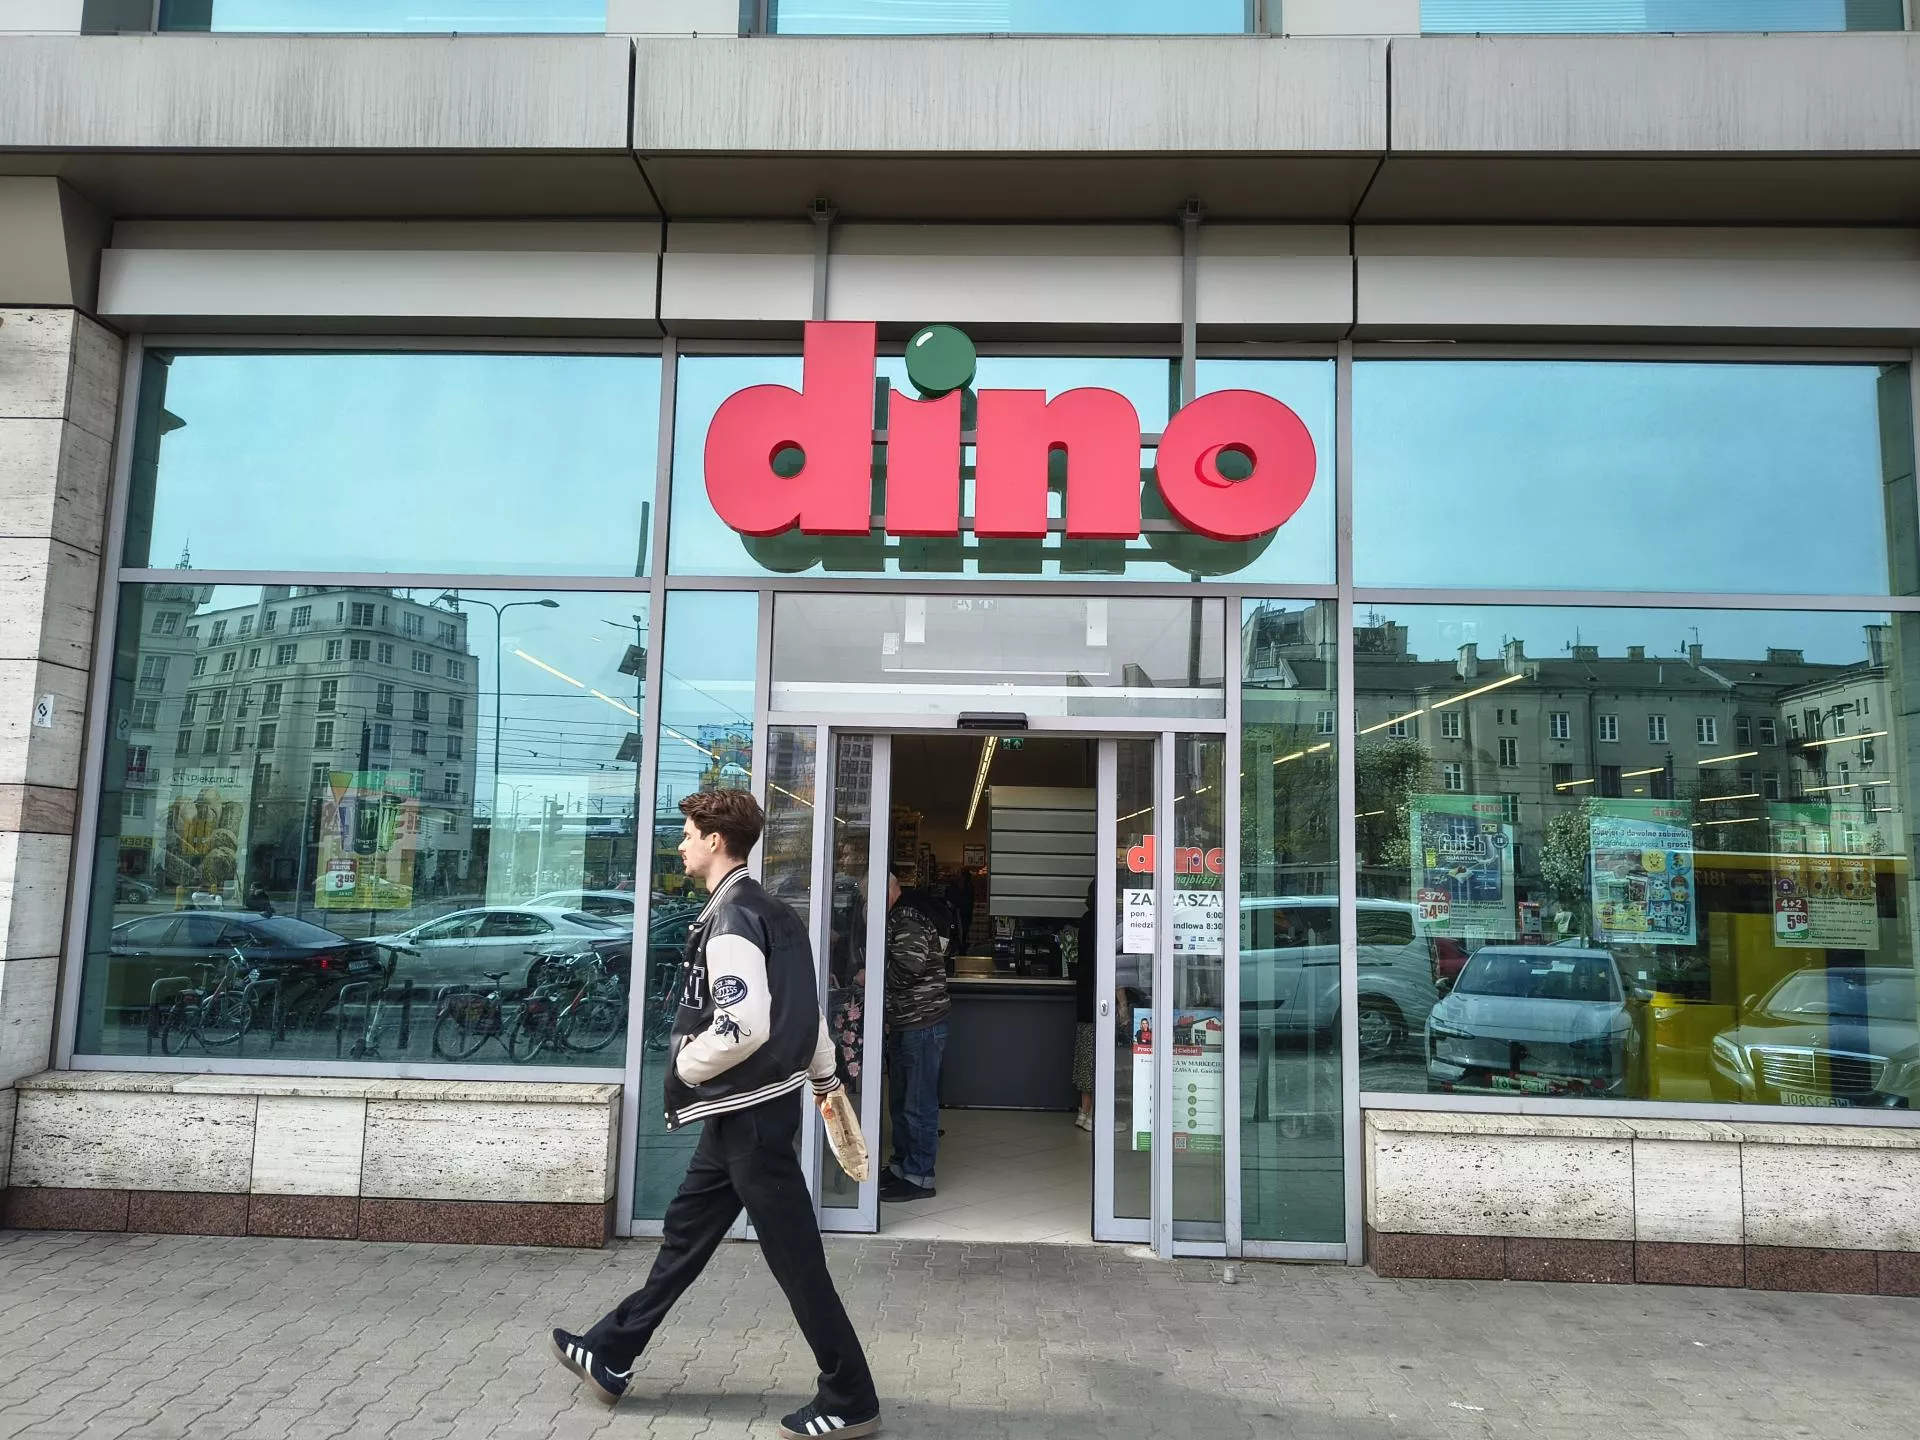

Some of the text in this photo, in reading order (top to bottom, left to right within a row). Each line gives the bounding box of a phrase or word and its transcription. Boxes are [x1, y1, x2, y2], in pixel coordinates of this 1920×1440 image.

[703, 320, 1316, 541] dino
[191, 774, 234, 783] Piekarnia
[1439, 833, 1486, 853] finish
[1127, 834, 1225, 874] dno
[1419, 891, 1447, 901] -37%
[1781, 899, 1803, 908] 4+2
[1130, 911, 1146, 919] pon.
